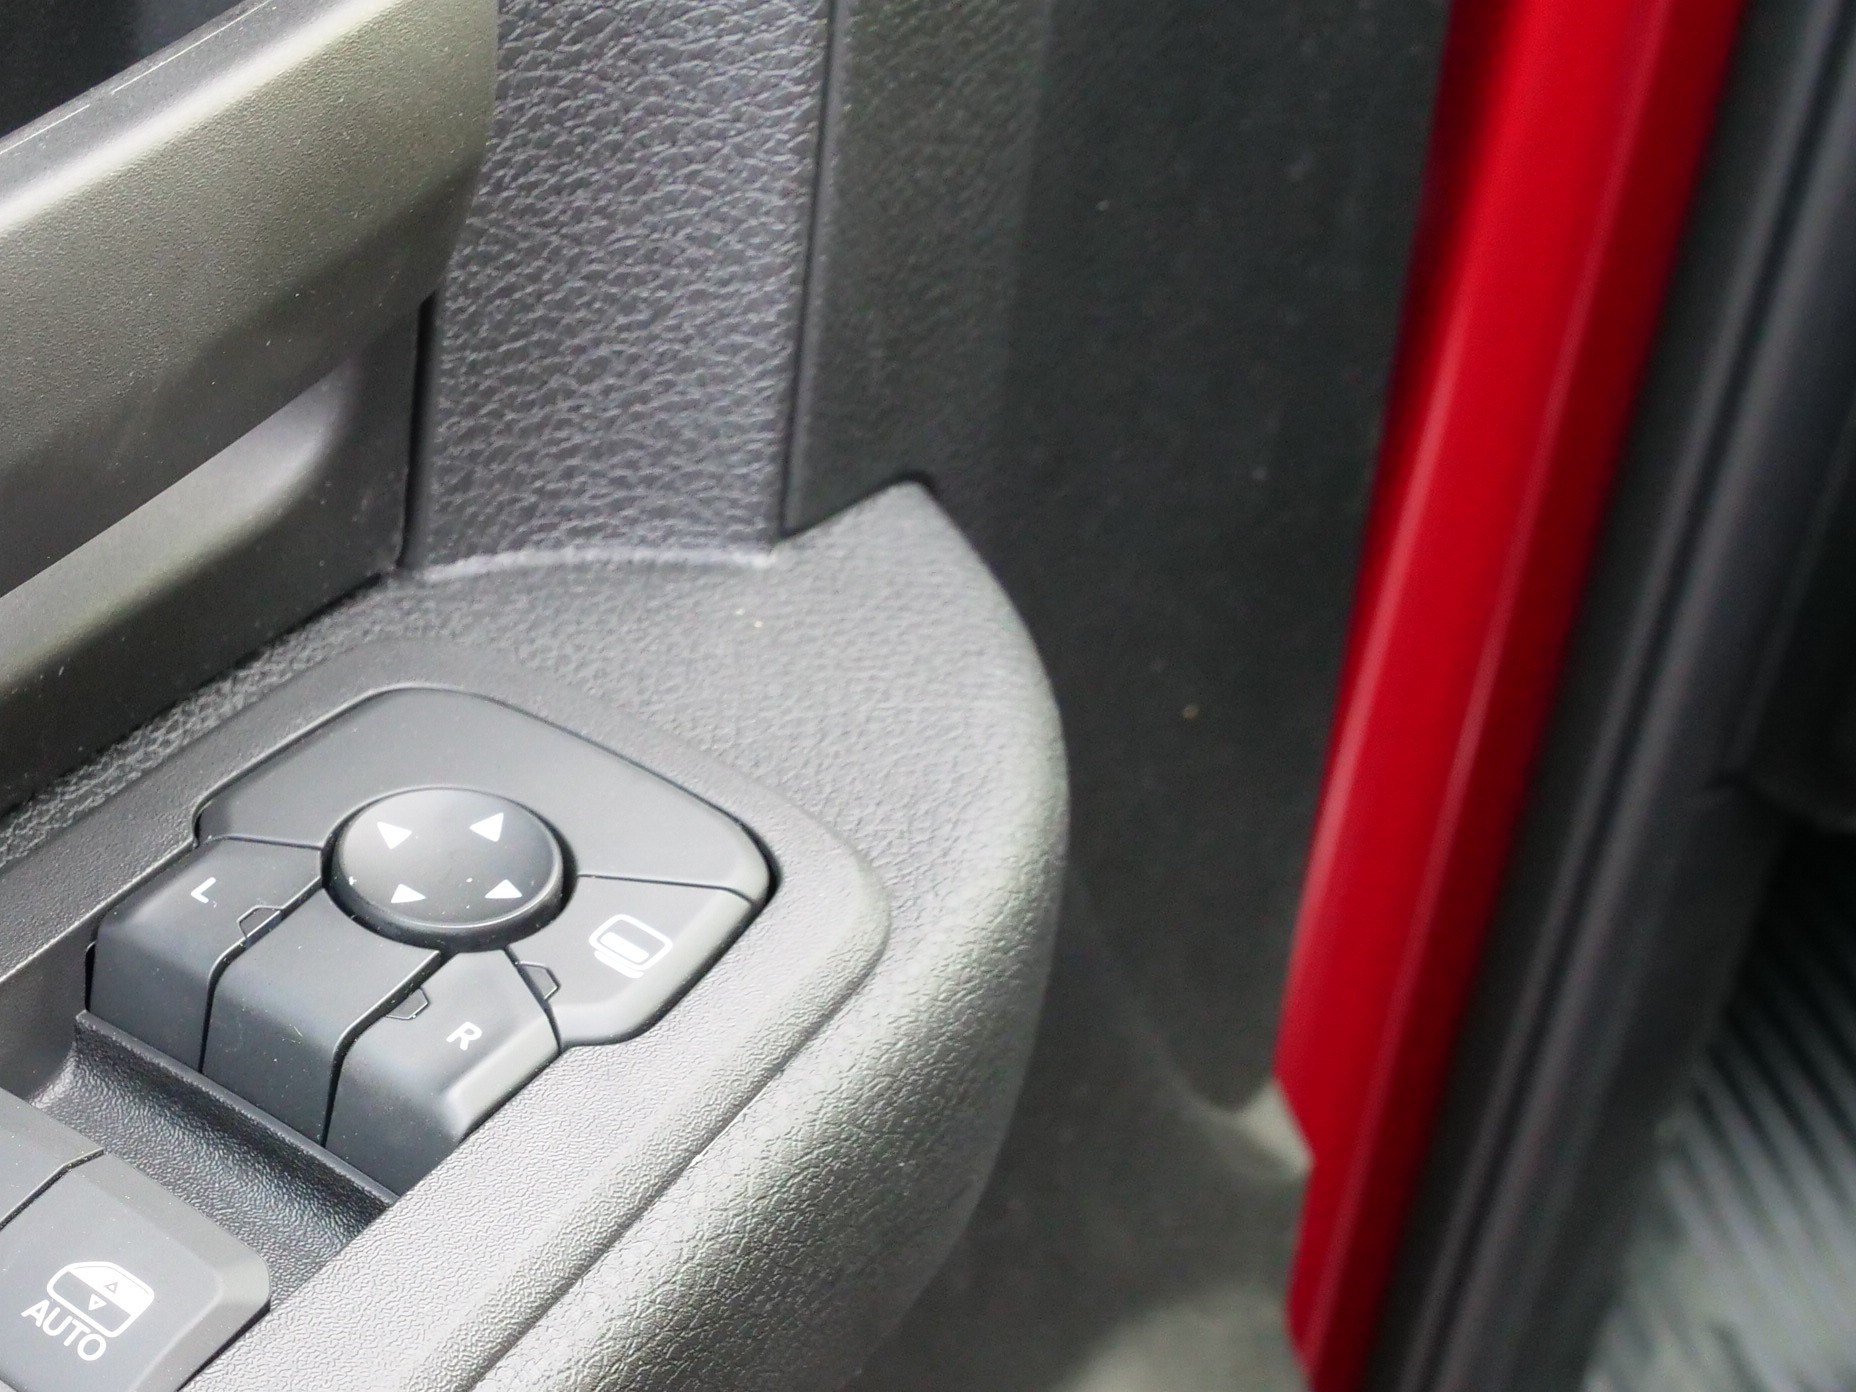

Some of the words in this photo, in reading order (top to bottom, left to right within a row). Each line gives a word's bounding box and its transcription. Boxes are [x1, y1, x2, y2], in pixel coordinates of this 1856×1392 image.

[190, 876, 217, 904] L
[446, 1021, 483, 1051] R
[21, 1299, 108, 1362] AUTO
